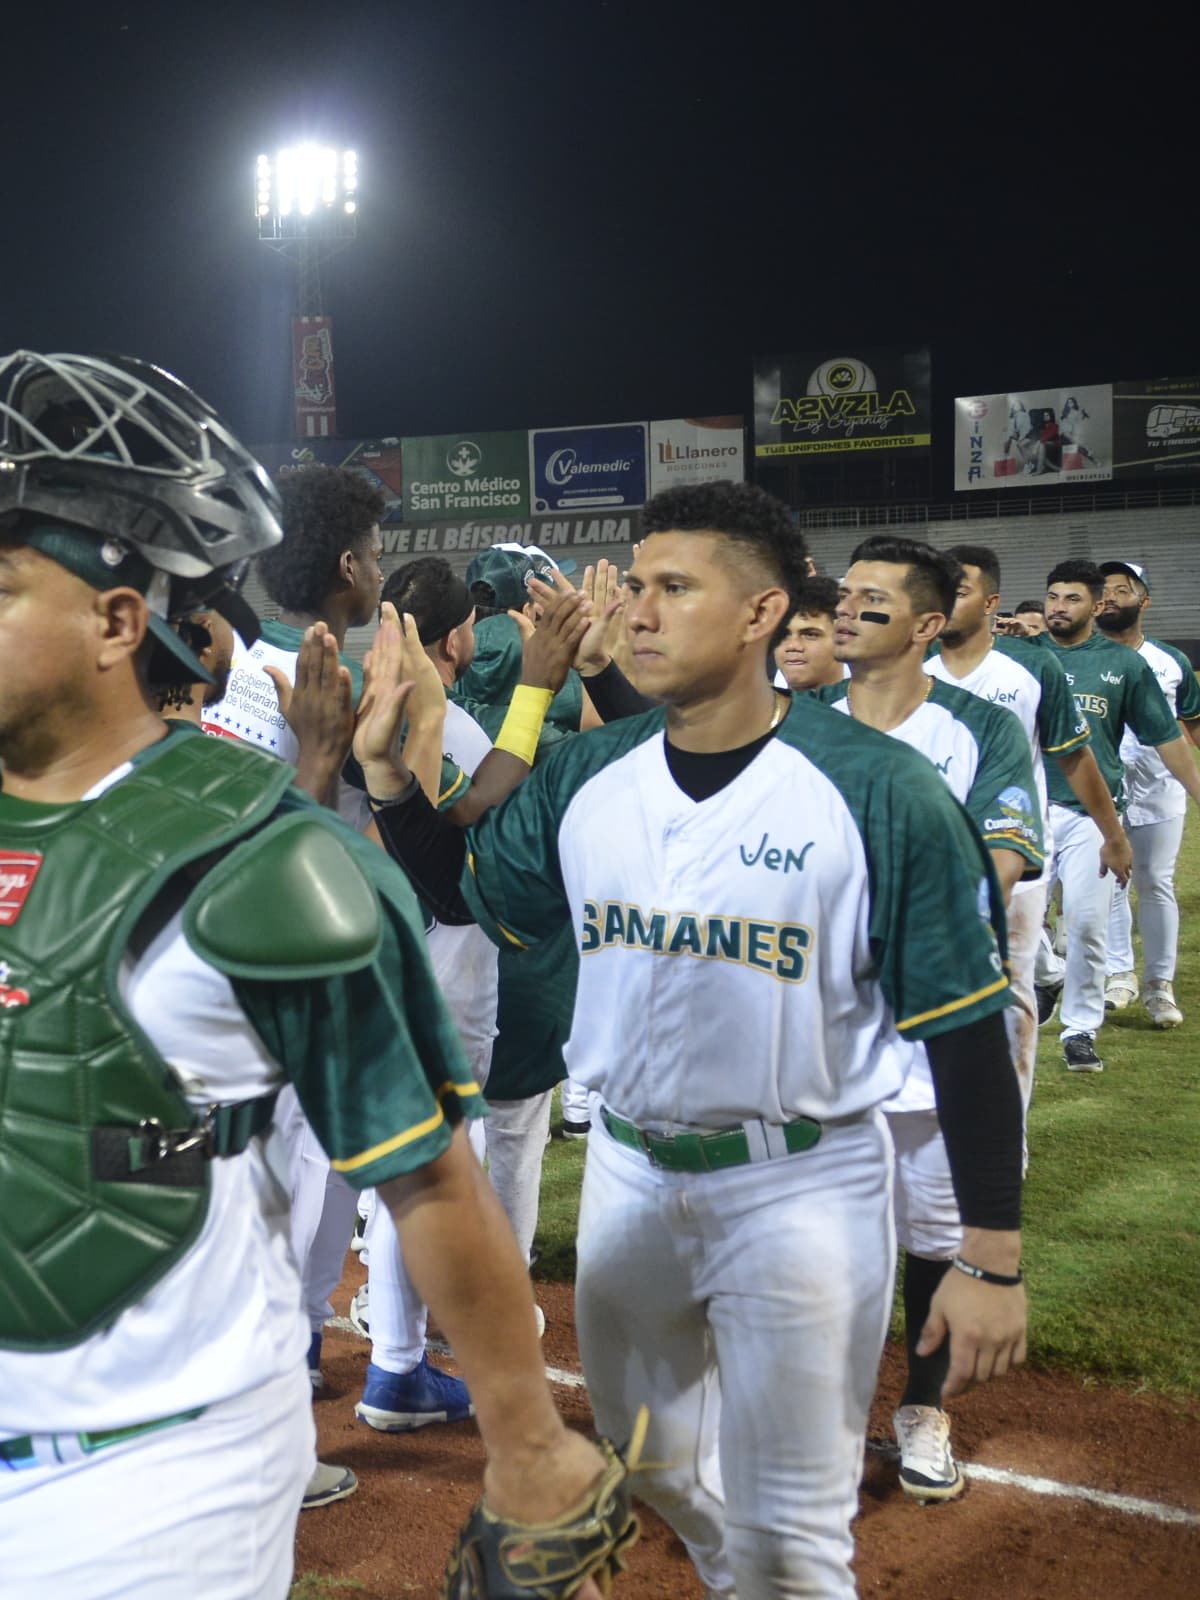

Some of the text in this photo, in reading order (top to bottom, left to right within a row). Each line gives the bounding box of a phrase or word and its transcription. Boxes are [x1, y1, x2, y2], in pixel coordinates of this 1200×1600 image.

[770, 390, 916, 425] A2VZLA
[676, 445, 738, 460] Llanero
[764, 437, 915, 454] TUS UNIFORMES FAVORITOS
[557, 458, 631, 476] Valemedic
[410, 477, 520, 495] Centro Médico
[410, 492, 521, 510] San Francisco
[413, 528, 438, 551] EL
[442, 521, 534, 550] BÉISBOL
[540, 523, 570, 546] EN
[573, 518, 631, 544] LARA
[234, 668, 276, 695] Gobierno
[230, 680, 279, 712] Bolivarian
[239, 698, 287, 730] Venezuela
[581, 898, 816, 985] SAMANES
